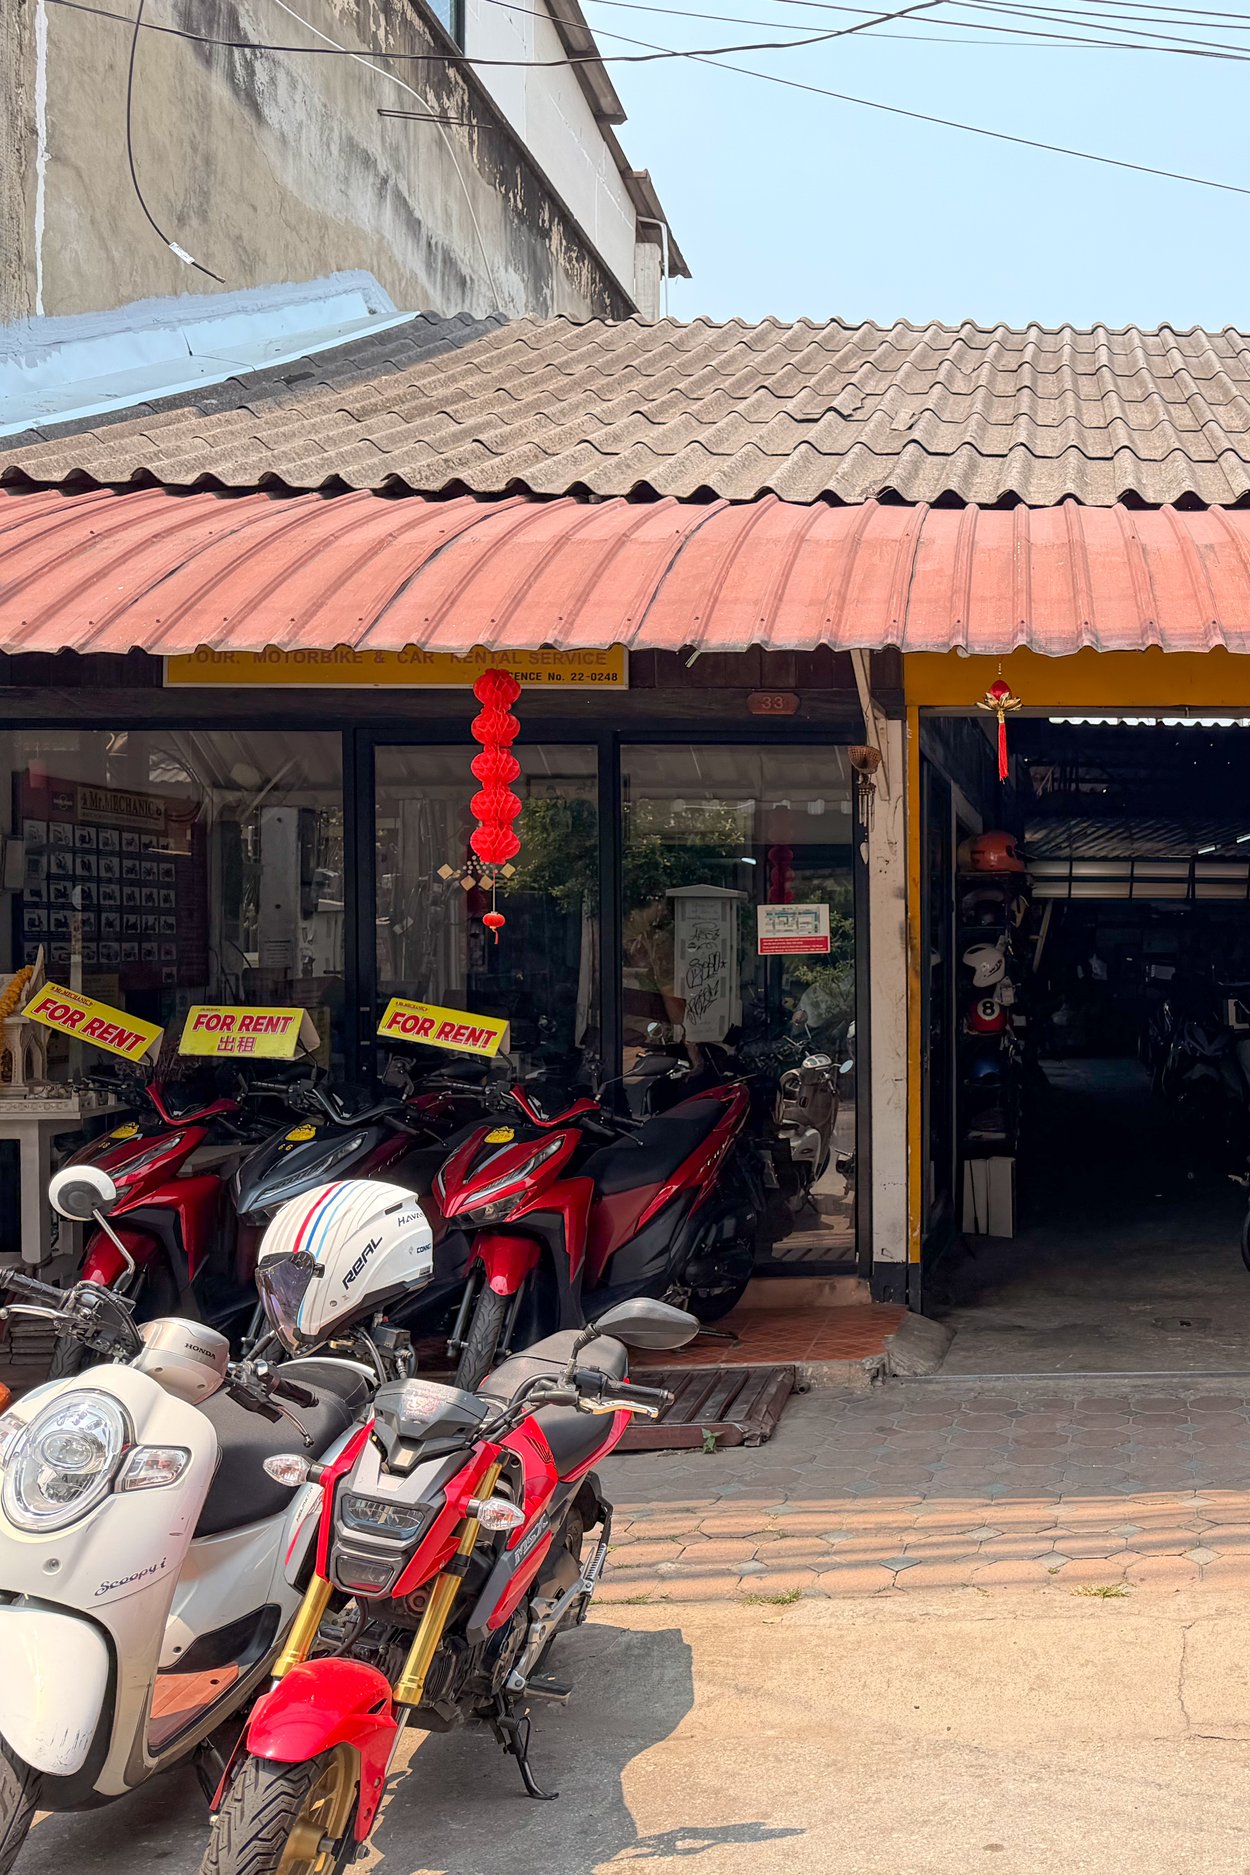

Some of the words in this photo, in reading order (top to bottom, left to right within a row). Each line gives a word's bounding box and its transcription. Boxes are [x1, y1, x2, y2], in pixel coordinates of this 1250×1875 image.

[253, 650, 363, 664] MOTORBIKE
[374, 650, 385, 664] &
[396, 651, 434, 664] CAR
[451, 652, 522, 664] RENTAL
[528, 652, 607, 666] SERVICE
[548, 672, 565, 681] No.
[570, 672, 618, 682] 22-0248
[761, 696, 784, 709] 33
[982, 1001, 994, 1016] 8
[32, 998, 86, 1030] FOR
[80, 1018, 147, 1052] RENT
[192, 1014, 236, 1032] FOR
[238, 1016, 294, 1034] RENT
[386, 1011, 436, 1038] FOR
[435, 1021, 498, 1048] RENT
[217, 1035, 256, 1052] 出租
[184, 1343, 216, 1360] HONDA
[94, 1564, 156, 1596] Scoopy
